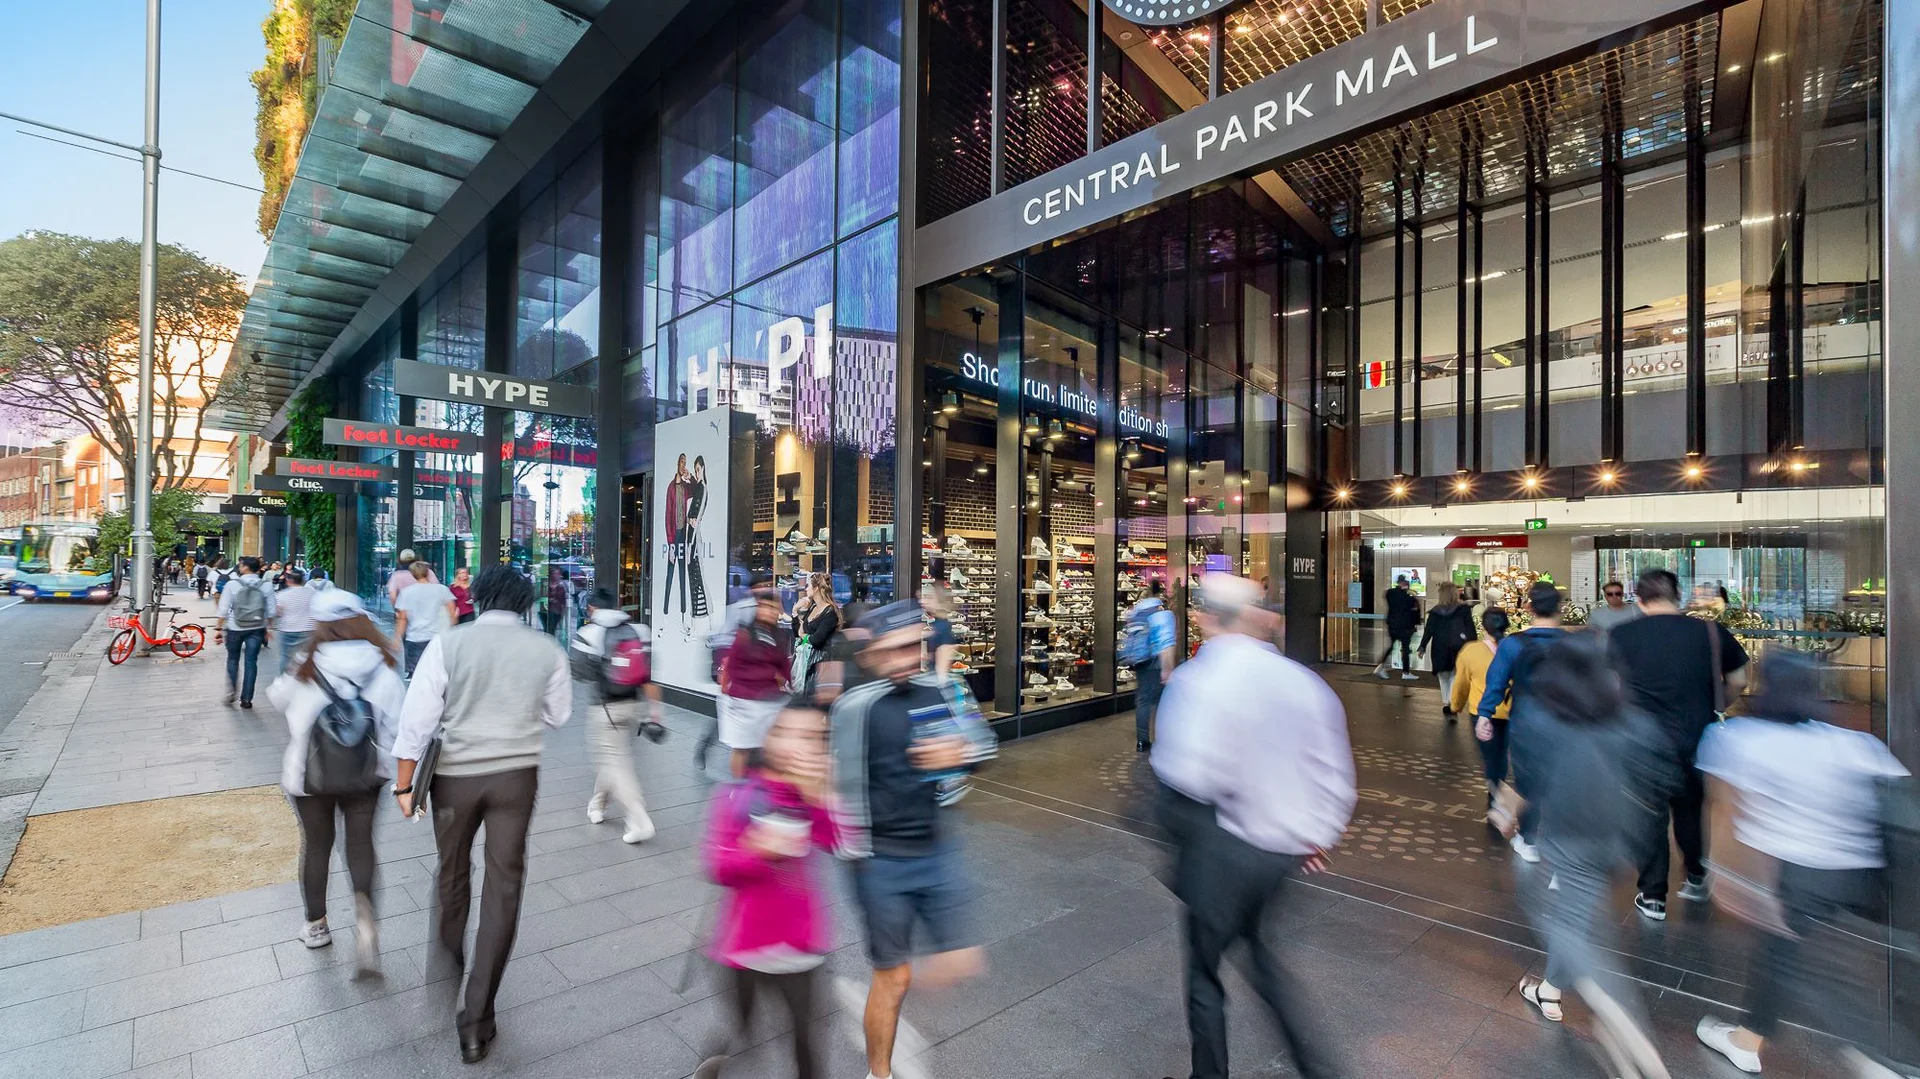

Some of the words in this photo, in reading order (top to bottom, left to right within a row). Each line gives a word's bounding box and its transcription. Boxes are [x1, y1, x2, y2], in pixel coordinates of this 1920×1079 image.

[1023, 144, 1181, 226] CENTRAL
[1196, 83, 1314, 161] PARK
[1335, 14, 1499, 106] MALL
[448, 372, 549, 407] HYPE
[963, 352, 999, 387] Sho
[1023, 377, 1055, 403] run,
[1059, 384, 1097, 416] limite
[1119, 406, 1152, 434] dition
[1156, 422, 1169, 439] sh
[343, 425, 388, 445] Foot
[395, 429, 460, 450] Locker
[290, 461, 325, 476] Foot
[329, 463, 381, 479] Locker
[287, 478, 324, 490] Glue.
[1293, 557, 1316, 573] HYPE
